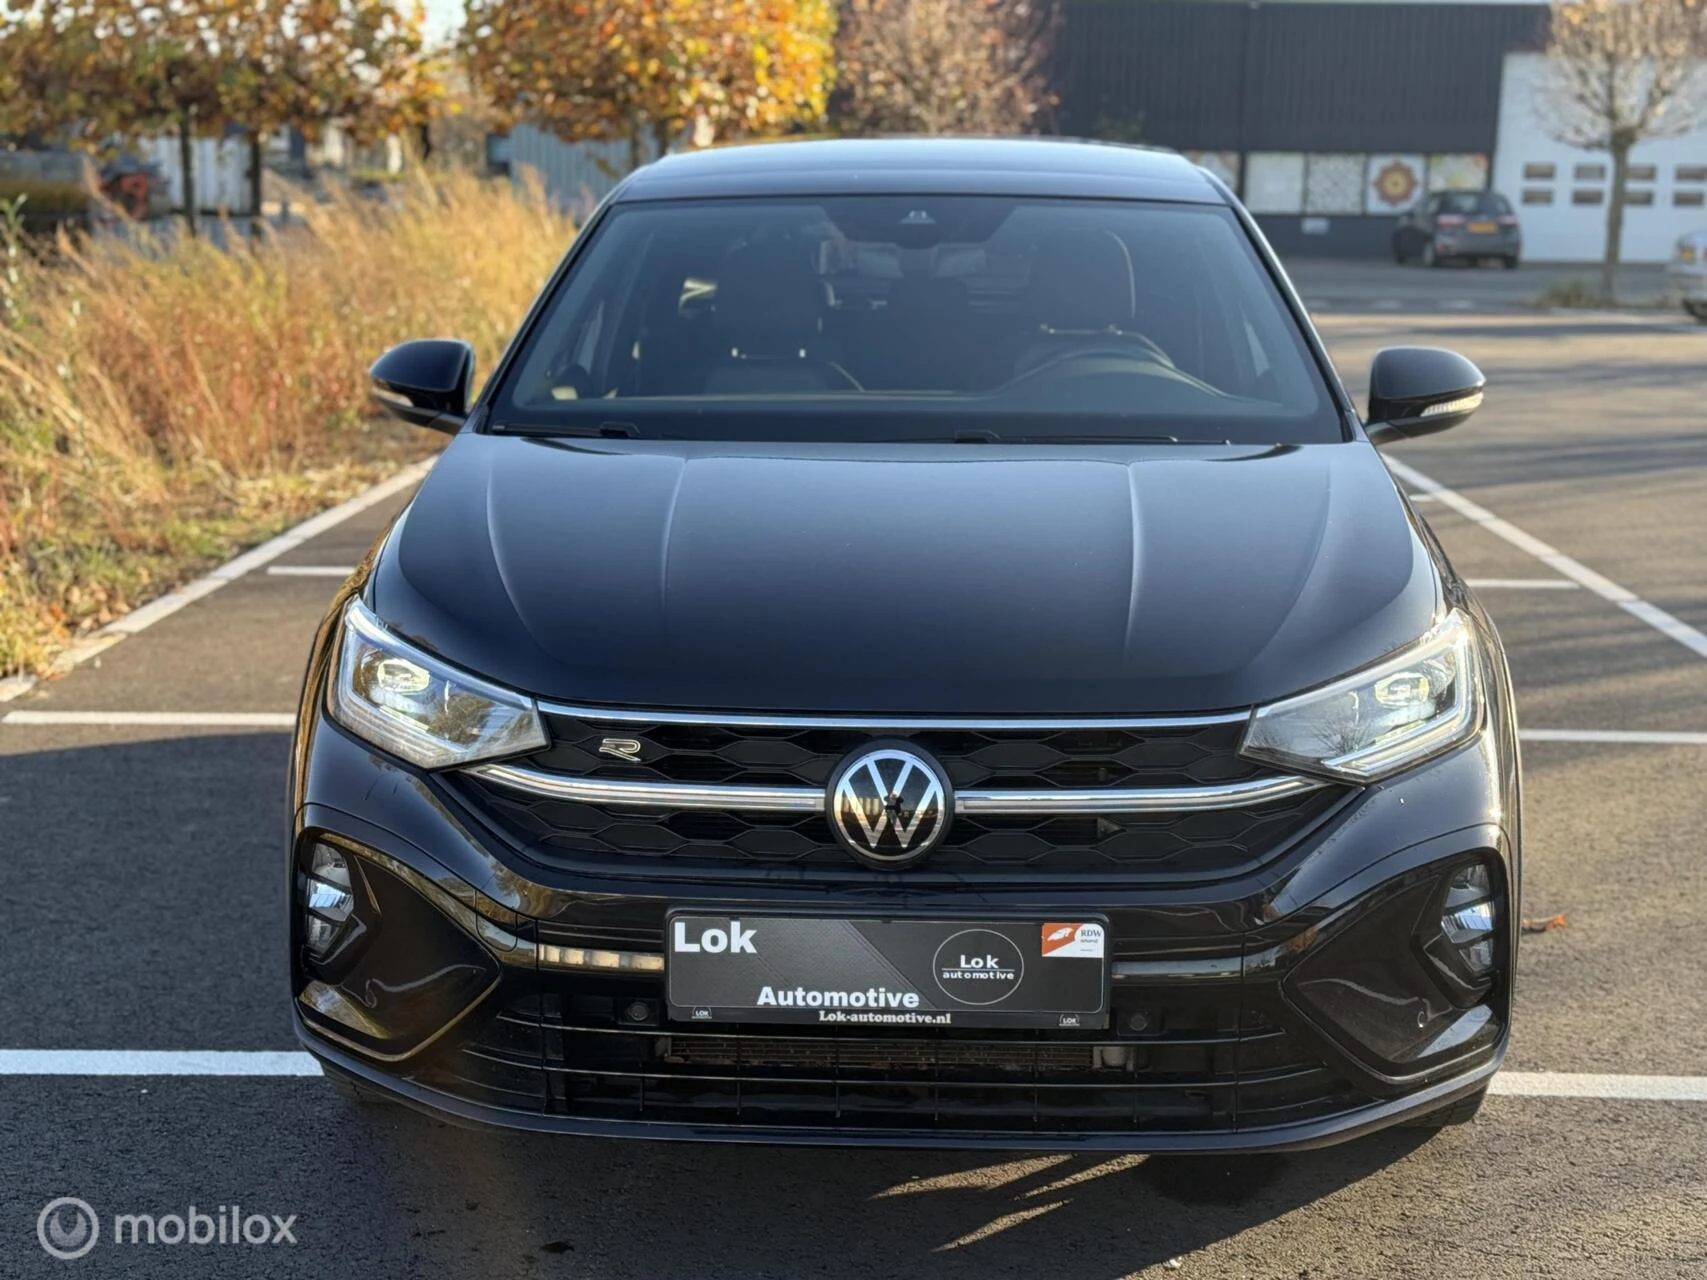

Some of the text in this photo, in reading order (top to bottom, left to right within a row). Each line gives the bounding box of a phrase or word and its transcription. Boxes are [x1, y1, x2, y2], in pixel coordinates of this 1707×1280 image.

[674, 921, 757, 954] Lok
[960, 954, 999, 969] Lok
[942, 971, 1015, 980] automotive
[756, 986, 920, 1008] Automotive
[818, 1010, 952, 1024] Lok-automotive.nl
